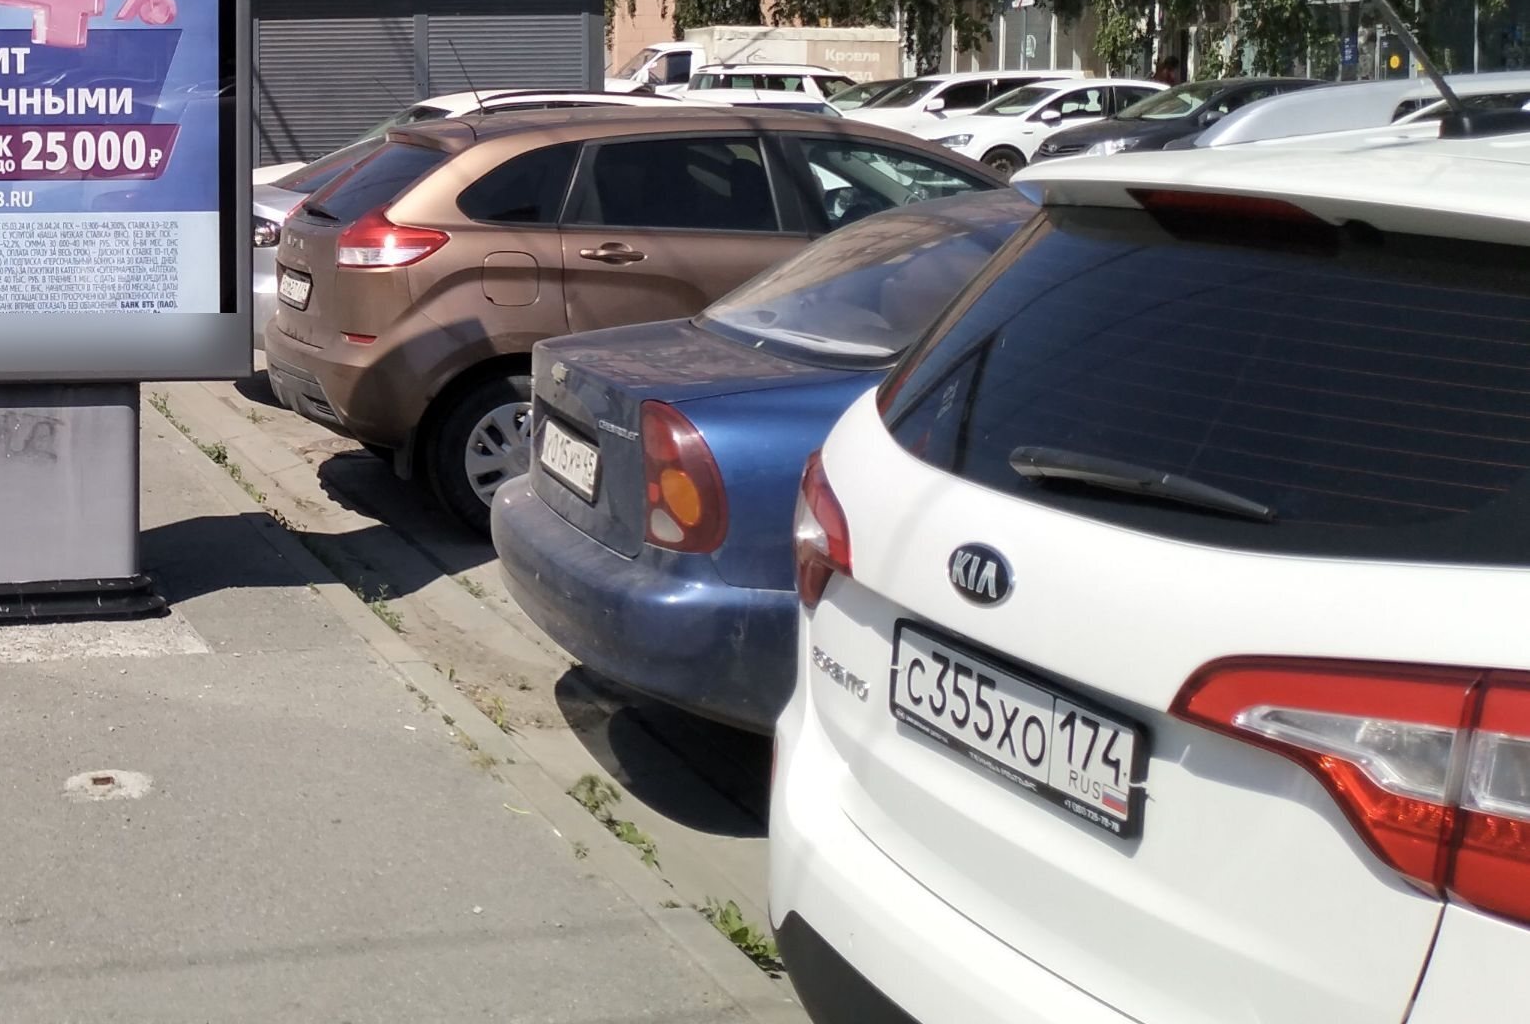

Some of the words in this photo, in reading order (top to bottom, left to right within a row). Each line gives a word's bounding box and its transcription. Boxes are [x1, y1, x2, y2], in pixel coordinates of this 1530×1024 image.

[825, 48, 880, 64] Кровля
[952, 550, 998, 599] KIA
[1058, 710, 1125, 786] 174
[1069, 770, 1101, 800] RUS
